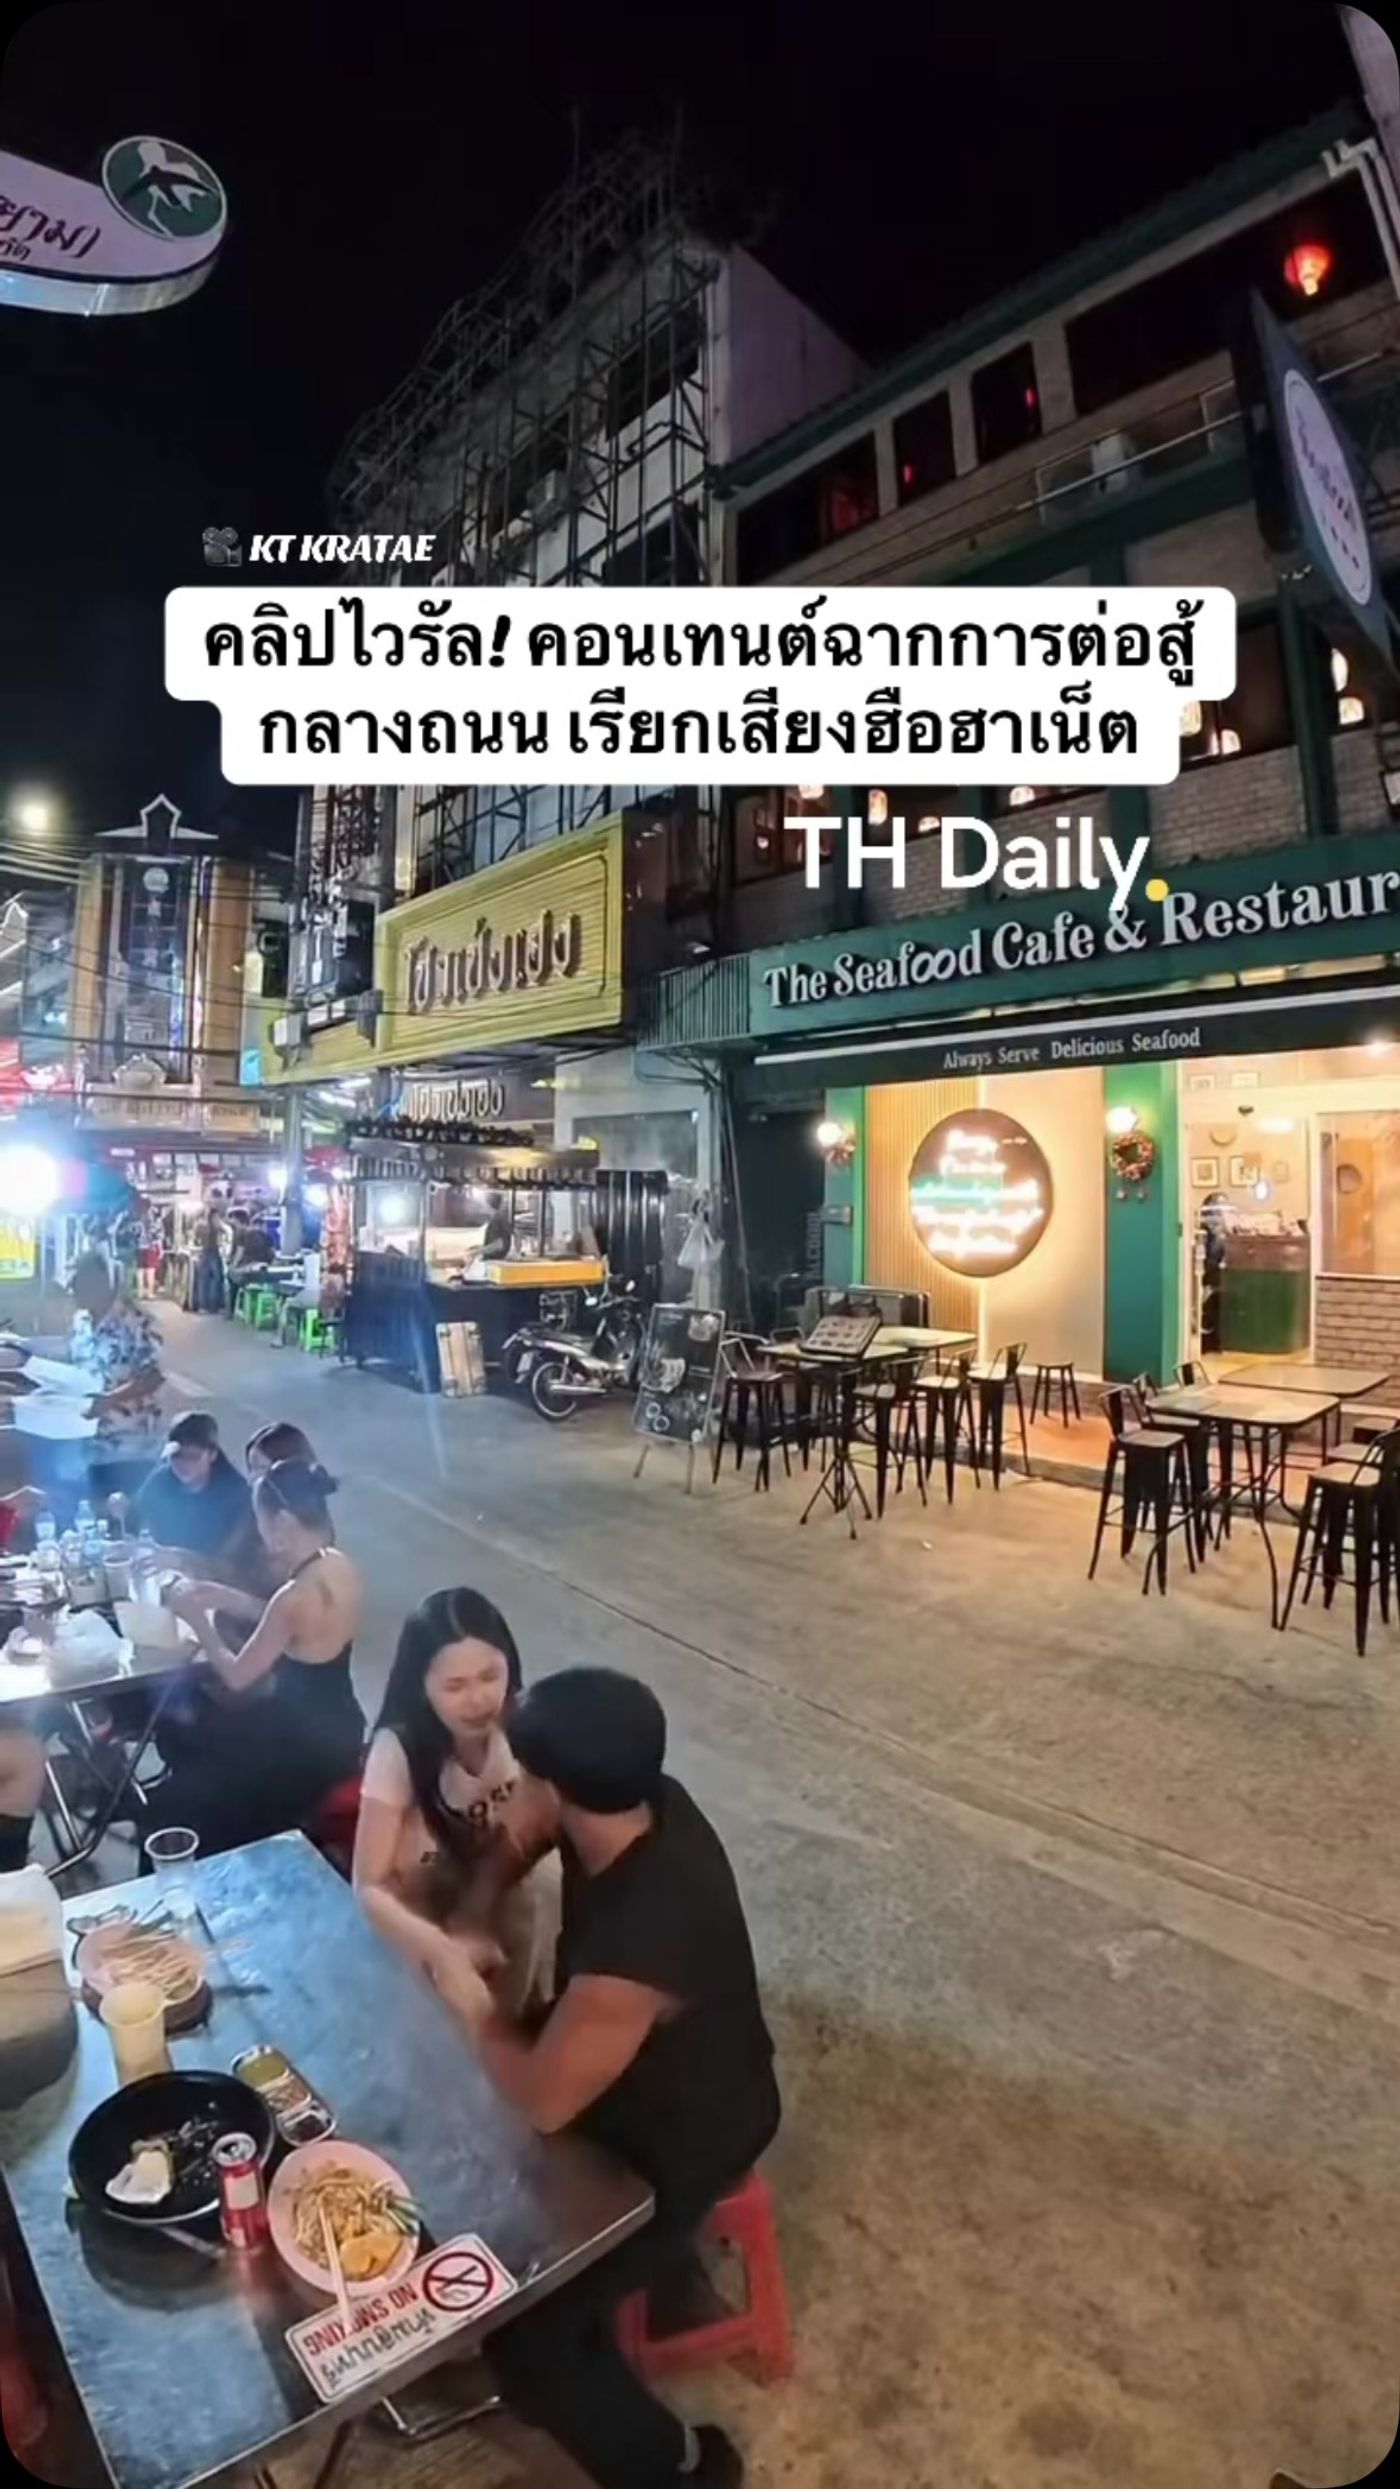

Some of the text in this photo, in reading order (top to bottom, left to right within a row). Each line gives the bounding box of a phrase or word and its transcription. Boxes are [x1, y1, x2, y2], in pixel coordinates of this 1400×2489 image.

[763, 963, 827, 1007] The
[833, 928, 982, 996] Seafood
[992, 911, 1095, 970] Cafe
[1161, 870, 1400, 946] Restaur
[943, 1027, 1201, 1073] Always Serve Delicious Seafood
[388, 2281, 419, 2310] NO
